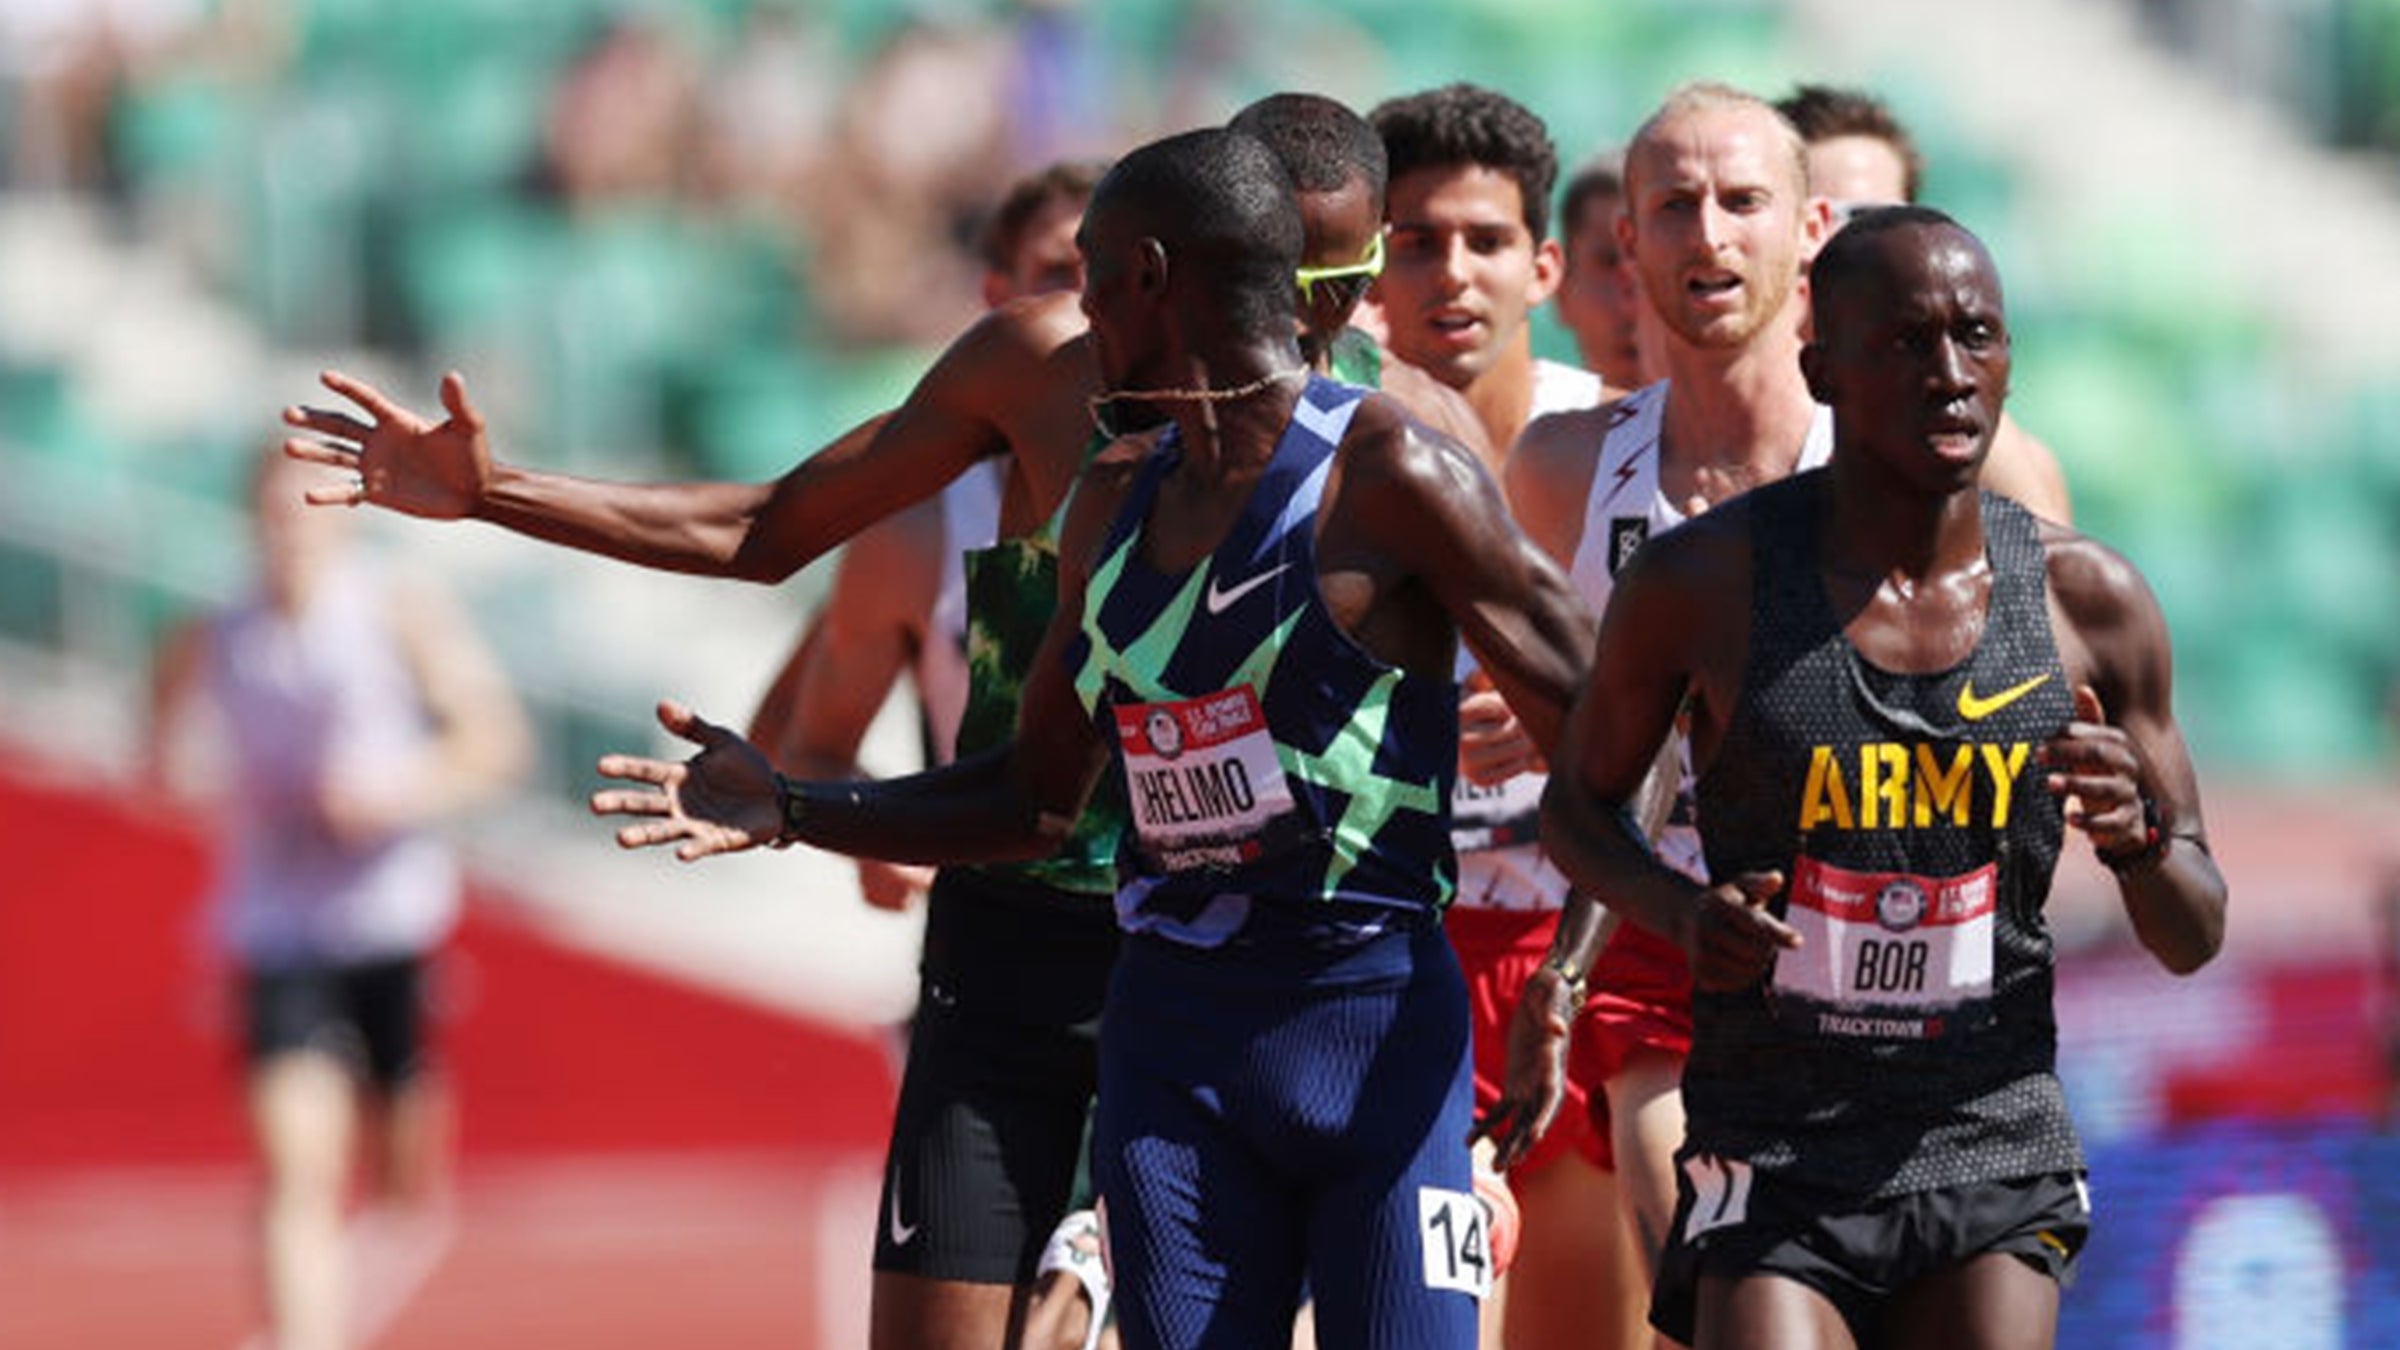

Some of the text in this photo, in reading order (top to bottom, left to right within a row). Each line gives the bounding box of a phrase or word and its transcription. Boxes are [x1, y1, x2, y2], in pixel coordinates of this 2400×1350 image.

[1801, 742, 2031, 829] ARMY
[1854, 939, 1929, 992] BOR
[1429, 1200, 1485, 1286] 14
